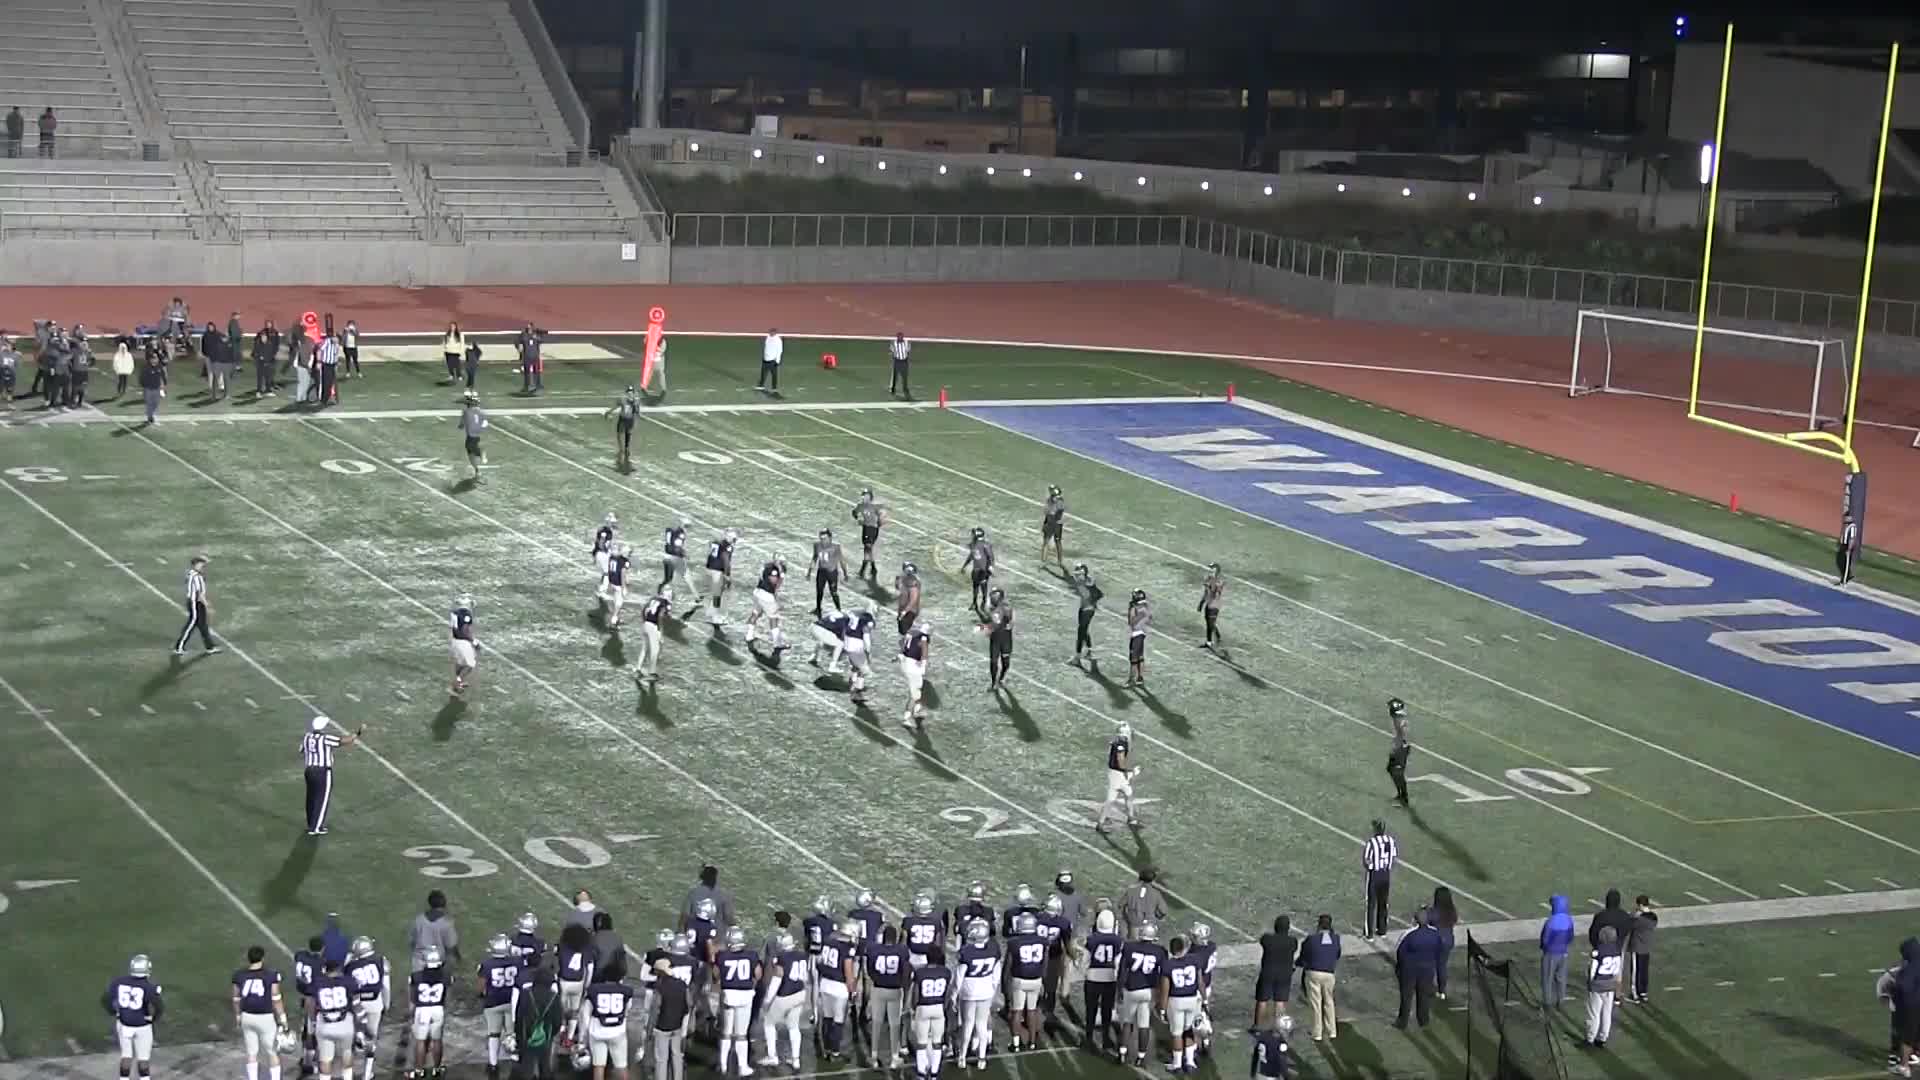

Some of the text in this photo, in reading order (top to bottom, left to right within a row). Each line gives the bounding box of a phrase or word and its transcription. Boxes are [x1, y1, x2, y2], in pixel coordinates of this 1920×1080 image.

[1118, 428, 1920, 718] WARRIO
[1405, 766, 1593, 804] 10
[939, 799, 1141, 839] 20
[403, 835, 612, 880] 30
[911, 924, 935, 944] 35
[568, 953, 583, 971] 4
[1019, 943, 1044, 964] 93
[1094, 944, 1113, 962] 41
[1131, 952, 1157, 975] 76
[724, 958, 750, 982] 70
[875, 955, 900, 974] 49
[970, 957, 996, 976] 77
[418, 983, 444, 1003] 33
